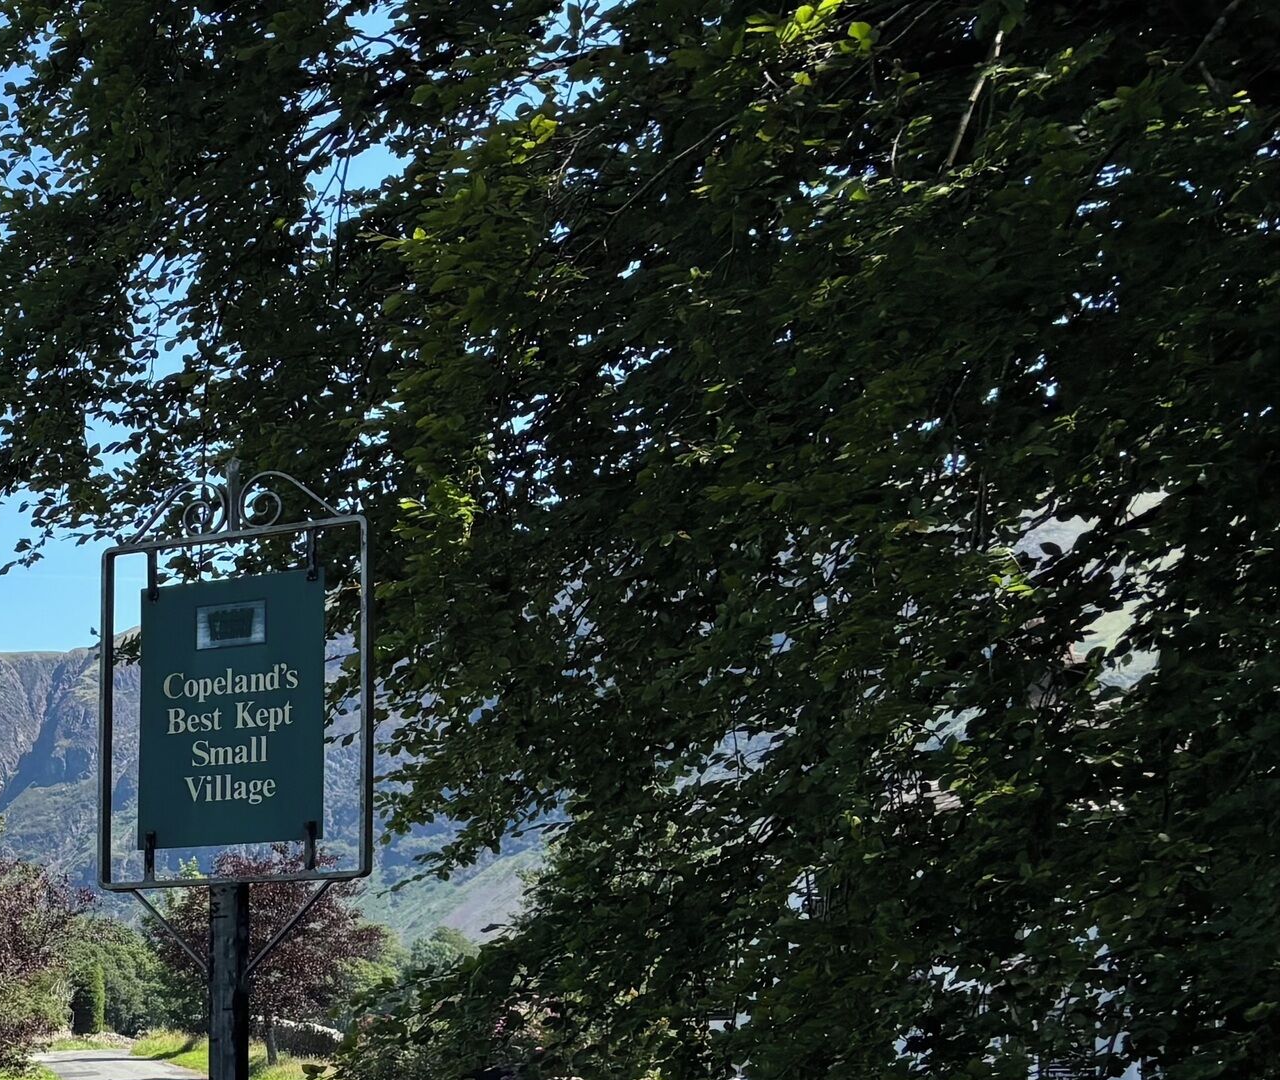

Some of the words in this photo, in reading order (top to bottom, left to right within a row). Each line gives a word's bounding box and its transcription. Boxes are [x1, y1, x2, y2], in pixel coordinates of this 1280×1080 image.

[163, 663, 299, 702] Copeland's
[167, 707, 222, 734] Best
[235, 700, 293, 732] Kept
[192, 735, 267, 767] Small
[184, 774, 276, 805] Village
